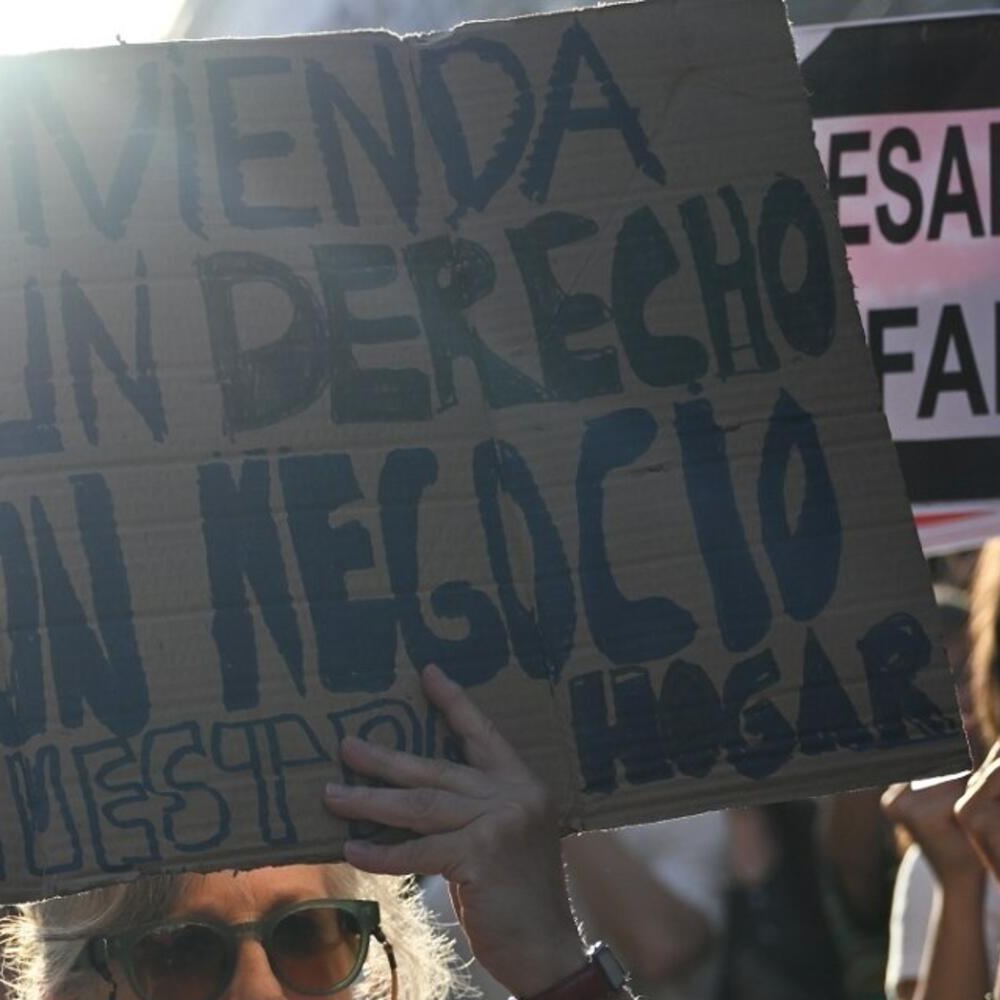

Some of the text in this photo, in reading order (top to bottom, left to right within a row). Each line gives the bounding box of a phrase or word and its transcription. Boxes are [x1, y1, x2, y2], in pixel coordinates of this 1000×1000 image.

[828, 122, 1000, 245] ESA
[194, 173, 836, 439] DERECHO
[868, 302, 1000, 419] FA
[197, 387, 843, 711] NEGOCIO
[568, 612, 964, 796] HOGAR
